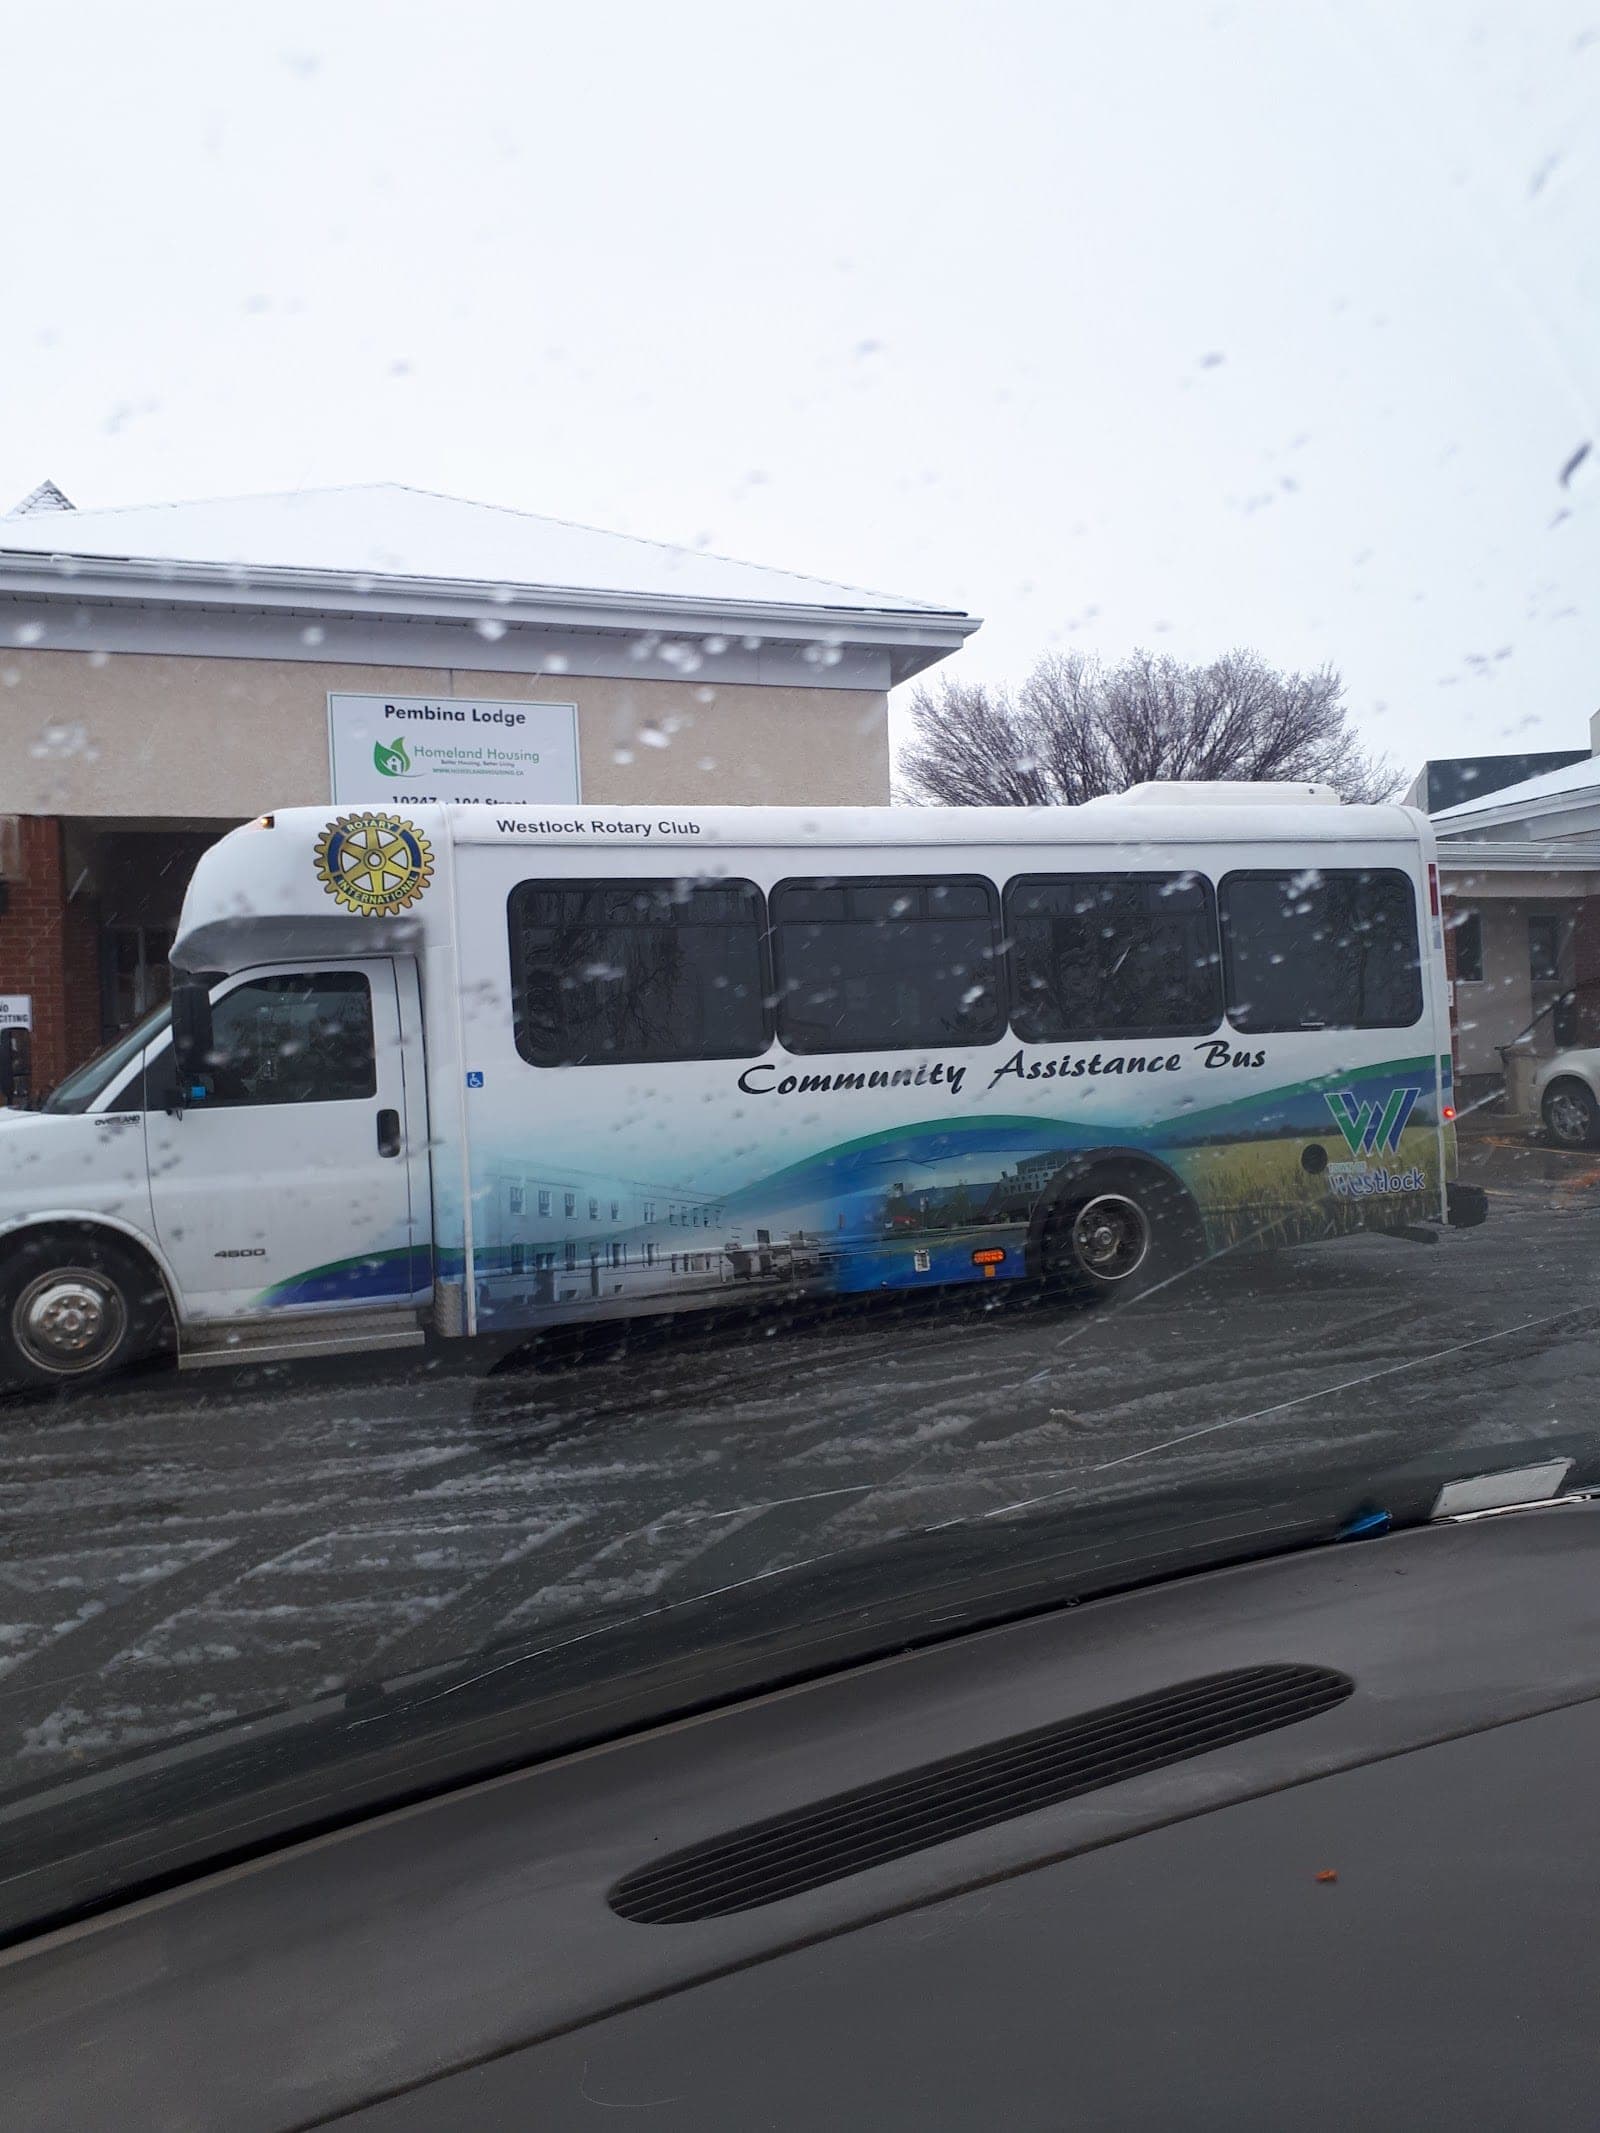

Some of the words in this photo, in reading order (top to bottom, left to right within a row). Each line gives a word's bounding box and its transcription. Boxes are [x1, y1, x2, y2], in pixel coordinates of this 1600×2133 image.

[384, 704, 466, 722] Pembina
[472, 708, 526, 727] Lodge
[414, 745, 482, 759] Homeland
[487, 748, 540, 764] Housing
[346, 820, 395, 832] ROTARY
[496, 819, 586, 834] Westlock
[591, 820, 652, 837] Rotary
[658, 821, 701, 835] Club
[340, 875, 418, 904] INTERNATIONAL
[737, 1063, 966, 1095] Community
[987, 1049, 1181, 1090] Assistance
[1193, 1040, 1266, 1069] Bus
[1327, 1166, 1426, 1195] Westlock
